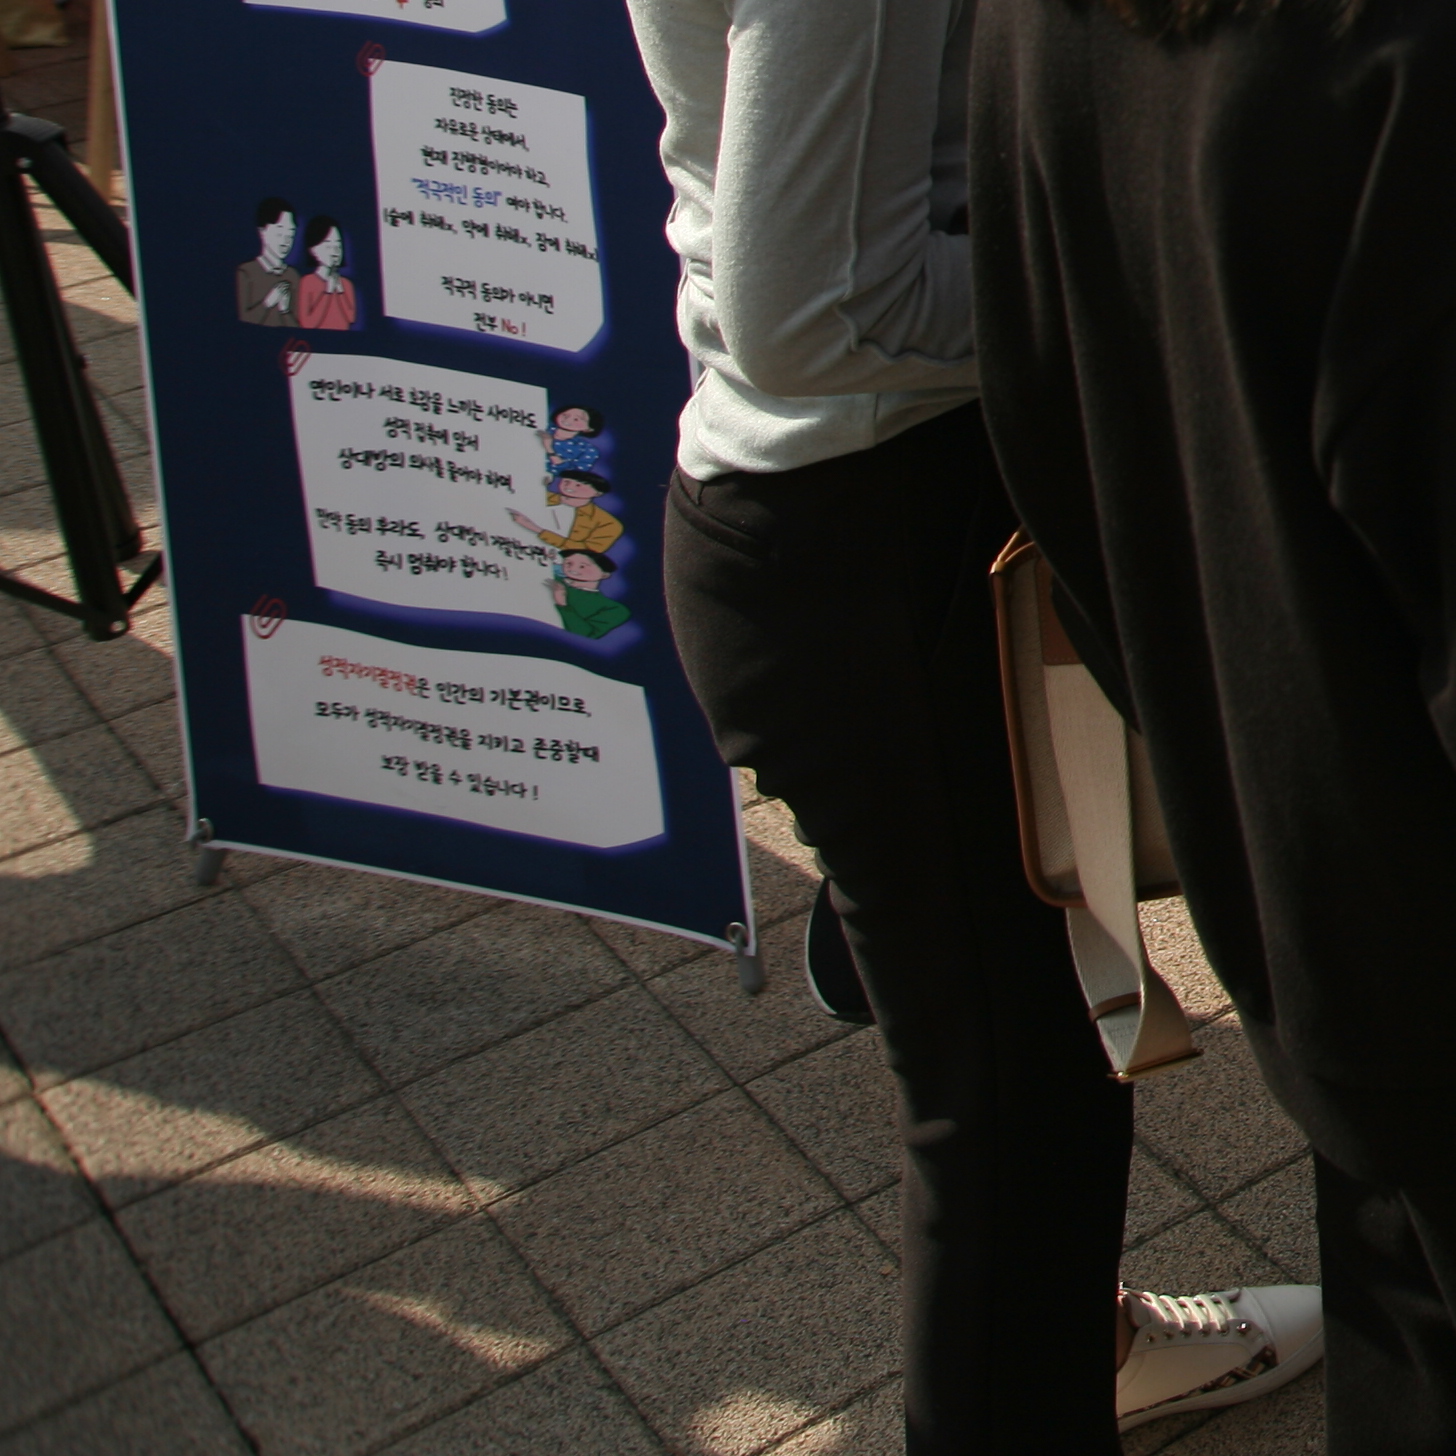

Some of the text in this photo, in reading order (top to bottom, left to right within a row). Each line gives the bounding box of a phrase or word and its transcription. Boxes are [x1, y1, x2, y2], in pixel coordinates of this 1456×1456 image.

[449, 86, 518, 119] 진정한 동의는
[434, 118, 479, 142] 자유로운
[420, 145, 448, 167] 현재
[441, 275, 554, 315] 적극적 동의가 아니면
[473, 312, 498, 333] 전부
[500, 318, 518, 335] No
[308, 379, 539, 429] 연인이나 서로 호감을 느끼는 사이라도
[383, 416, 413, 440] 성적
[453, 431, 479, 453] 앞서
[337, 447, 406, 472] 상대방의
[408, 454, 445, 478] 의사를
[314, 507, 342, 532] 만약
[345, 514, 372, 535] 동의
[434, 521, 489, 547] 상대방이
[375, 549, 403, 571] 즉시
[406, 552, 457, 576] 멈춰야
[318, 654, 430, 699] 성적자기결정권은
[435, 681, 485, 705] 인간의
[314, 701, 360, 722] 모두가
[364, 707, 473, 750] 성적자기결정권을
[478, 733, 526, 754] 지키고
[381, 754, 410, 777] 보장
[414, 760, 444, 785] 받을
[449, 770, 463, 785] 수
[467, 772, 528, 798] 있습니다
